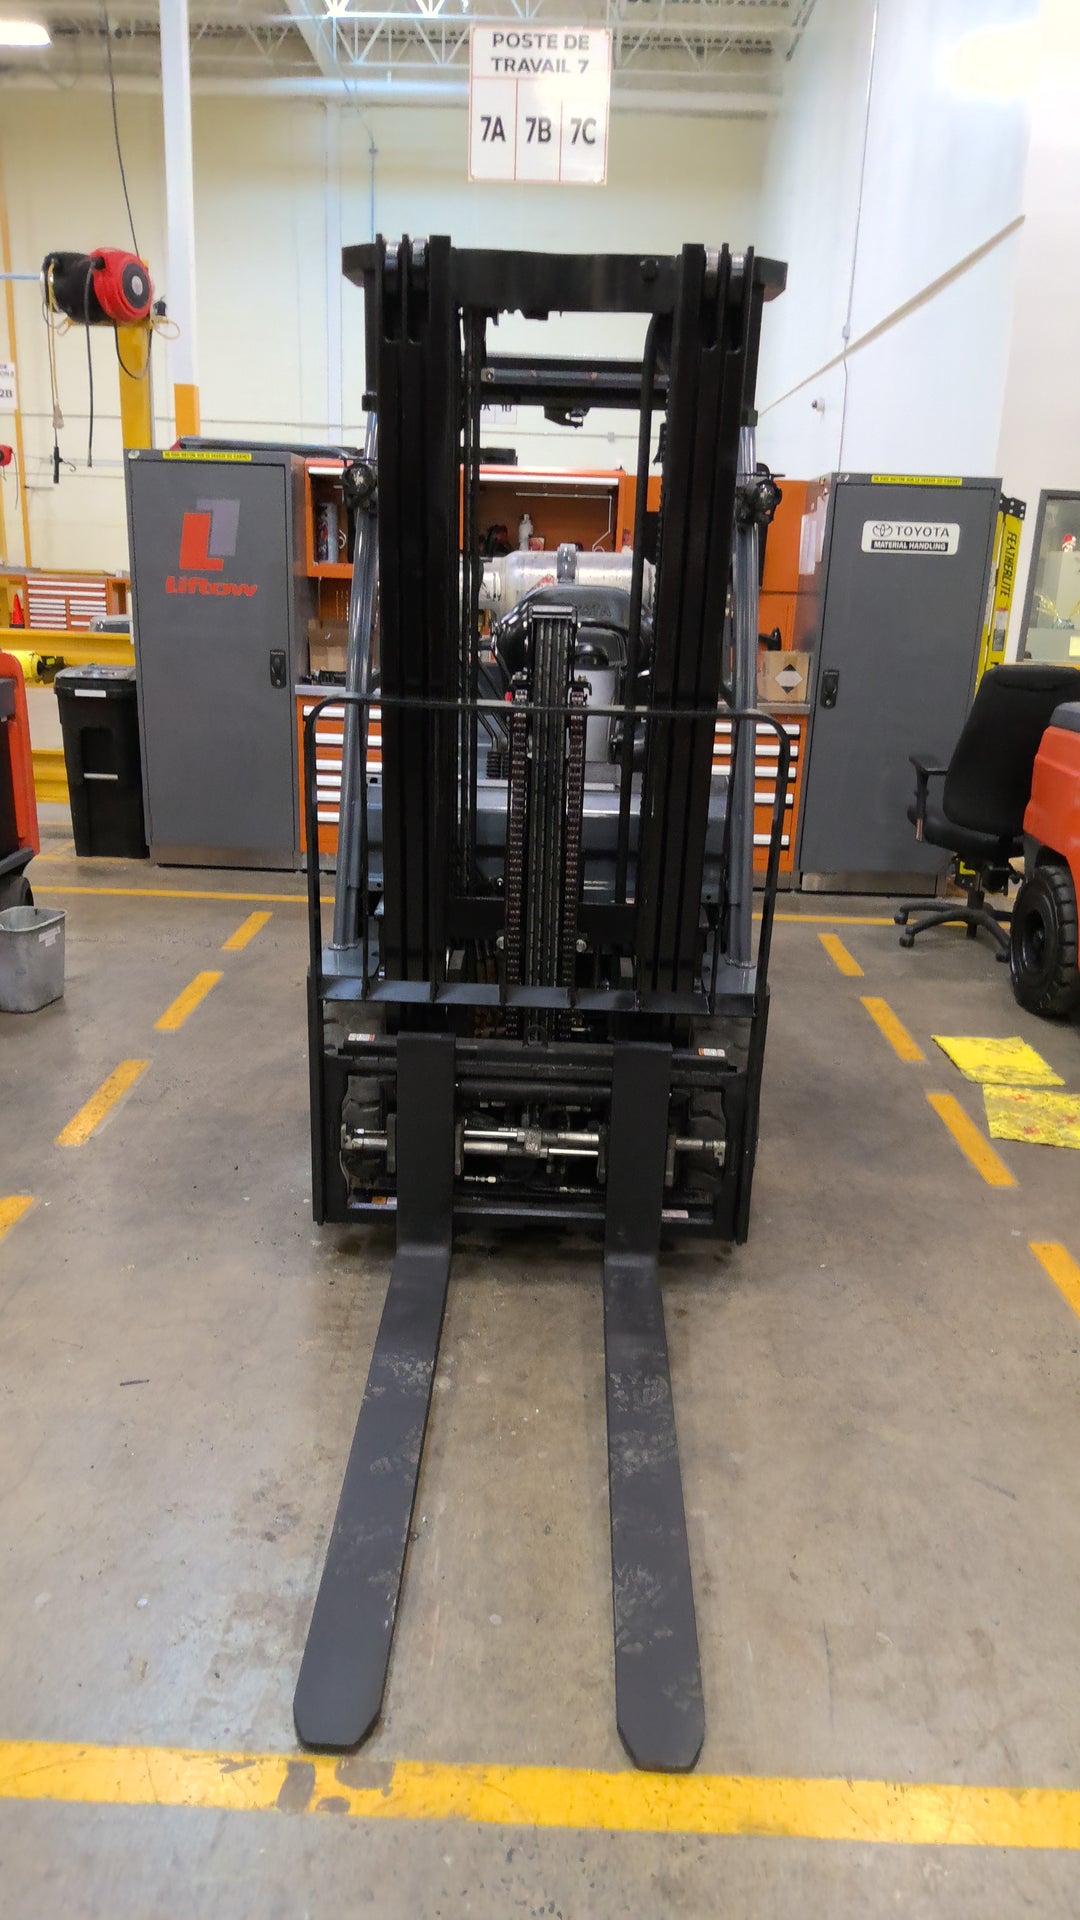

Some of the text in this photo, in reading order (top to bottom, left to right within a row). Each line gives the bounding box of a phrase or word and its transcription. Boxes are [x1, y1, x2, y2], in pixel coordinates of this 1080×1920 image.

[492, 32, 590, 50] POSTE DE
[490, 57, 589, 74] TRAVAIL 7
[480, 115, 506, 142] 7A
[525, 117, 552, 144] 7B
[570, 117, 597, 145] 7C
[895, 525, 949, 537] TOYOTA
[873, 541, 946, 551] MATERIAL HANDLING
[1000, 531, 1018, 598] FEATHERLITE
